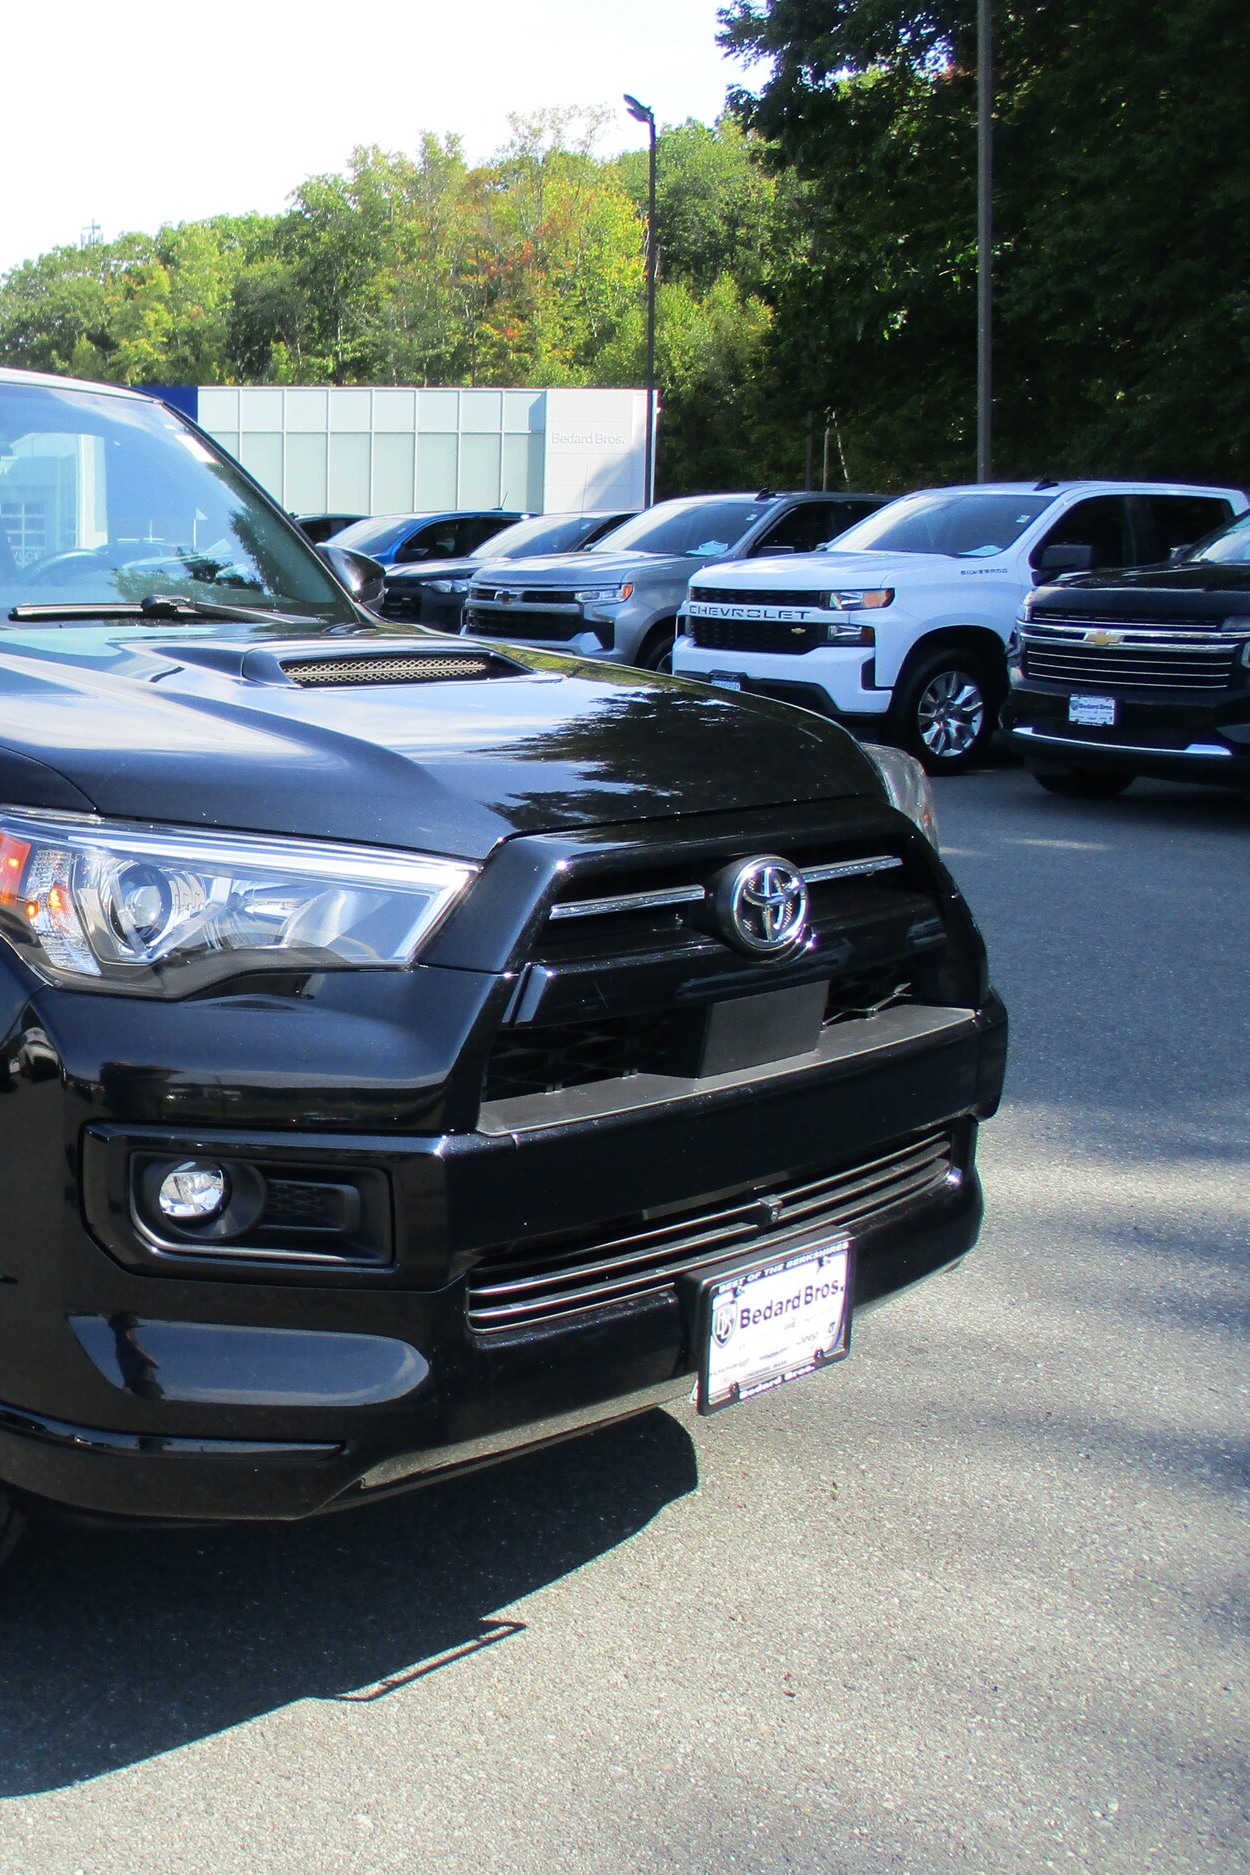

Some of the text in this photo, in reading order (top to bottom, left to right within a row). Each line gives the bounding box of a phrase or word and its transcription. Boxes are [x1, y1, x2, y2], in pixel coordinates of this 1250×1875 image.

[551, 432, 625, 445] Bedard Bros.
[689, 605, 811, 619] CHEVROLET
[718, 1241, 849, 1293] BEST OF THE BERKSHIRES
[739, 1279, 845, 1330] Bedard Bros.
